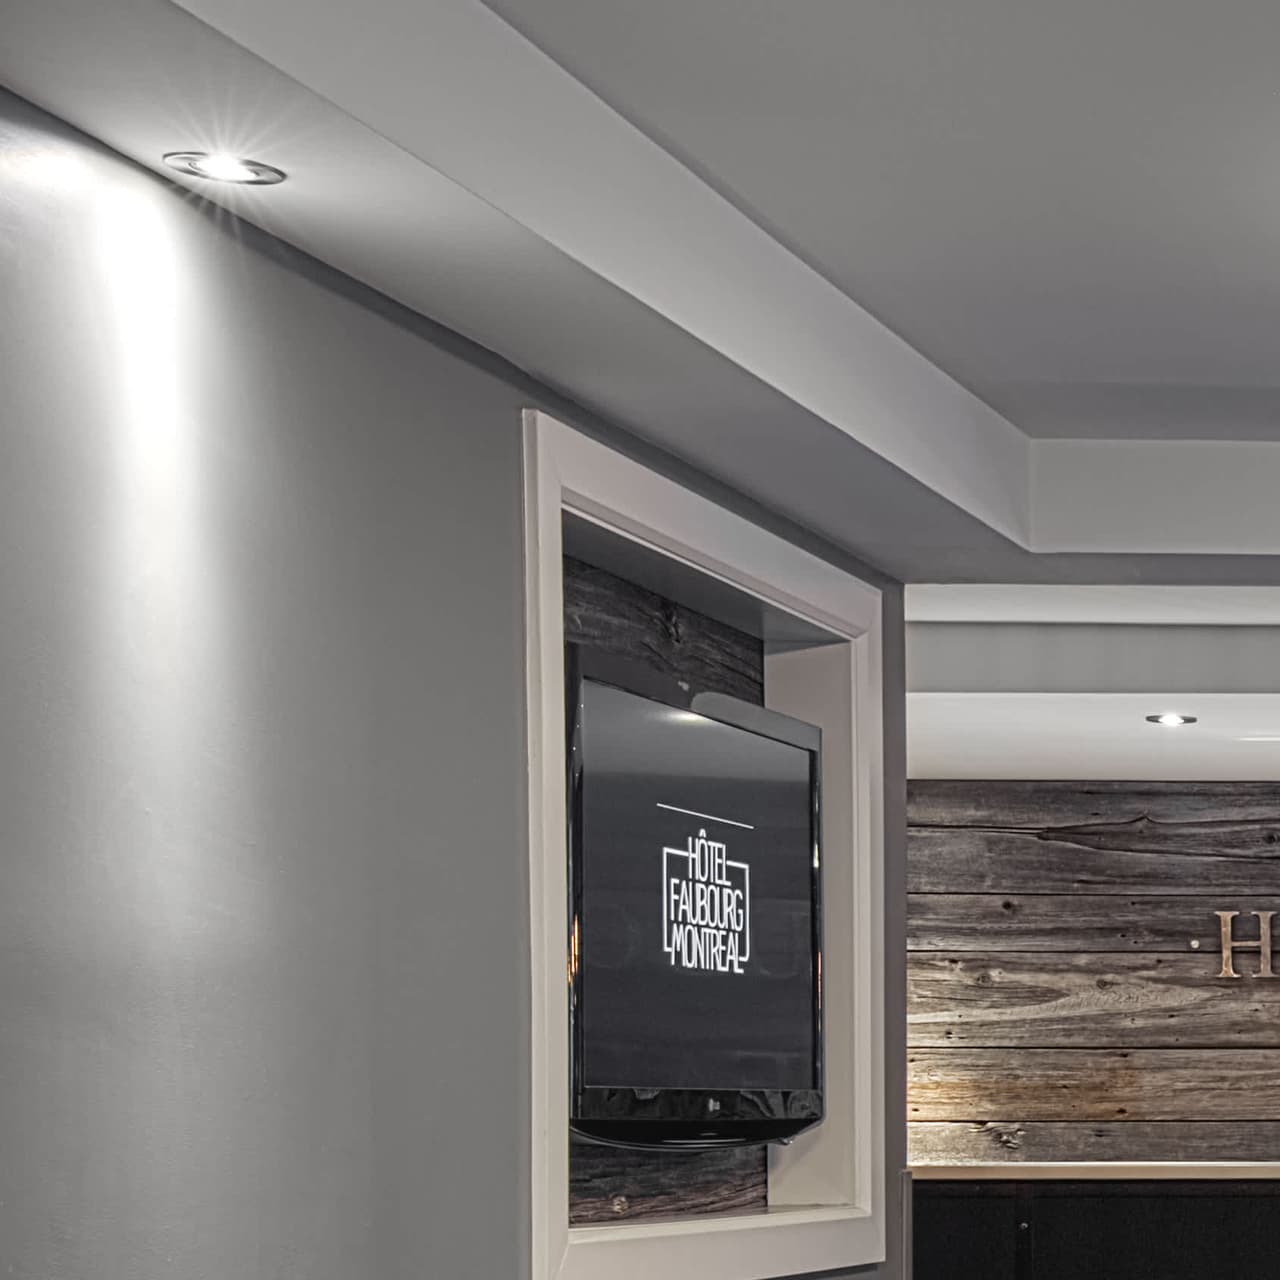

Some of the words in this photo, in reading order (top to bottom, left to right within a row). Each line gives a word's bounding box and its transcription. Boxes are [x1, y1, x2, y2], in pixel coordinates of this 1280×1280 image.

[687, 828, 732, 886] HÔTEL
[670, 876, 744, 932] FAUBOURG
[670, 922, 745, 974] MONTREAL
